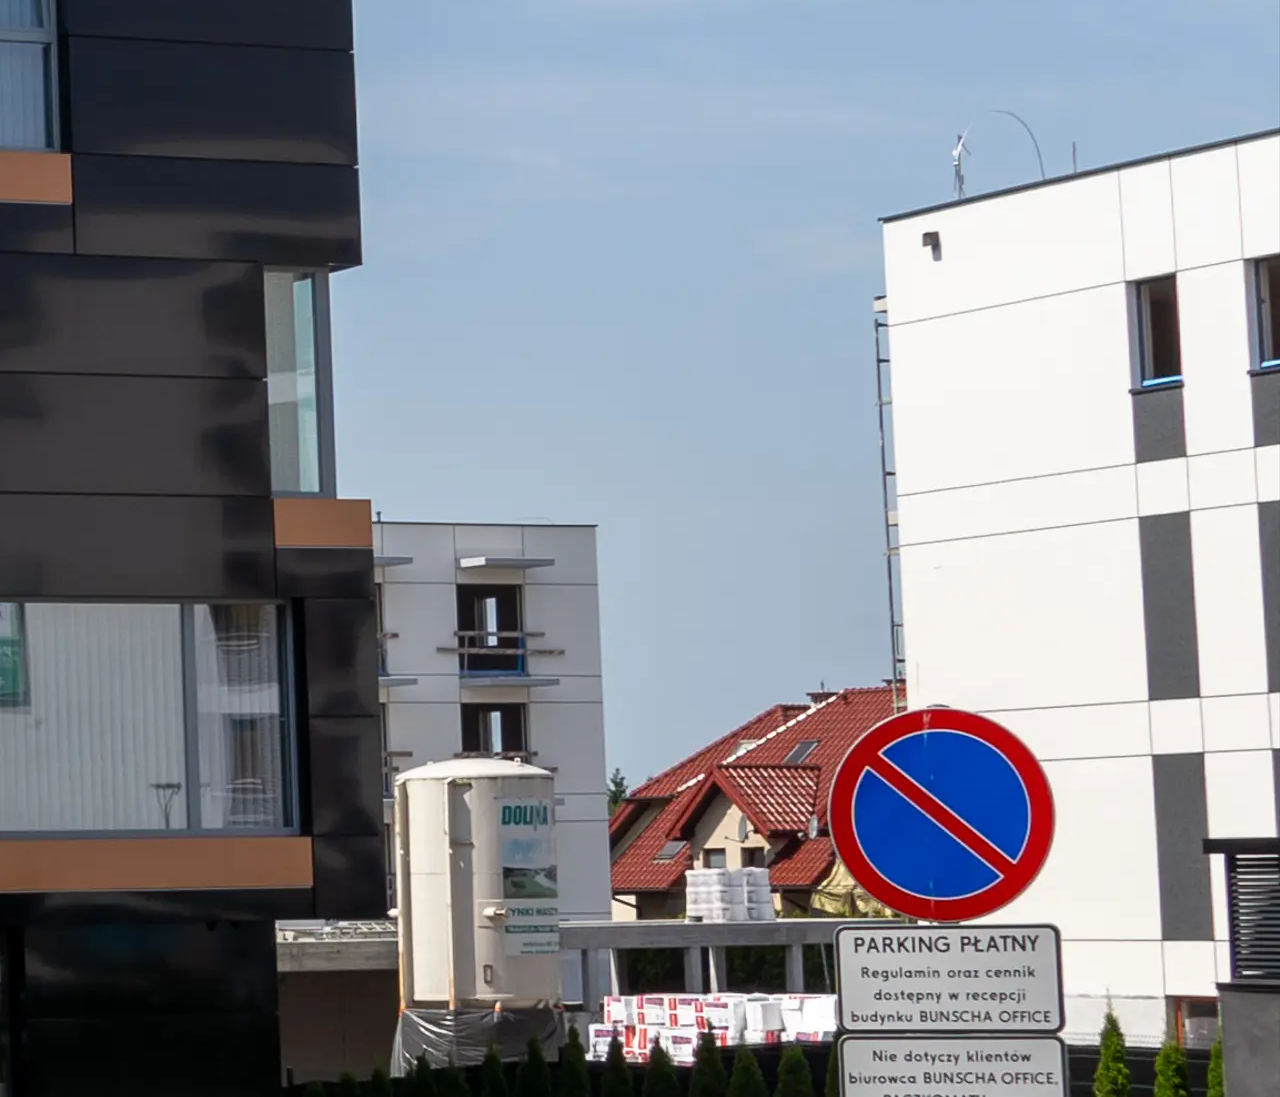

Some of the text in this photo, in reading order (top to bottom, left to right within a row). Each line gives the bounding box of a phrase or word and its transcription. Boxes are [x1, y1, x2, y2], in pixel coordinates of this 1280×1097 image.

[853, 934, 1040, 954] PARKING PŁATNY
[860, 965, 1037, 982] Regulamin oraz cennik
[873, 988, 1027, 1004] dostępny w recepcji
[850, 1010, 1052, 1026] budynku BUNSCHA OFFICE
[871, 1049, 1032, 1066] Nie dotyczy klientów
[848, 1072, 917, 1085] biurowca
[922, 1072, 997, 1085] BUNSCHA
